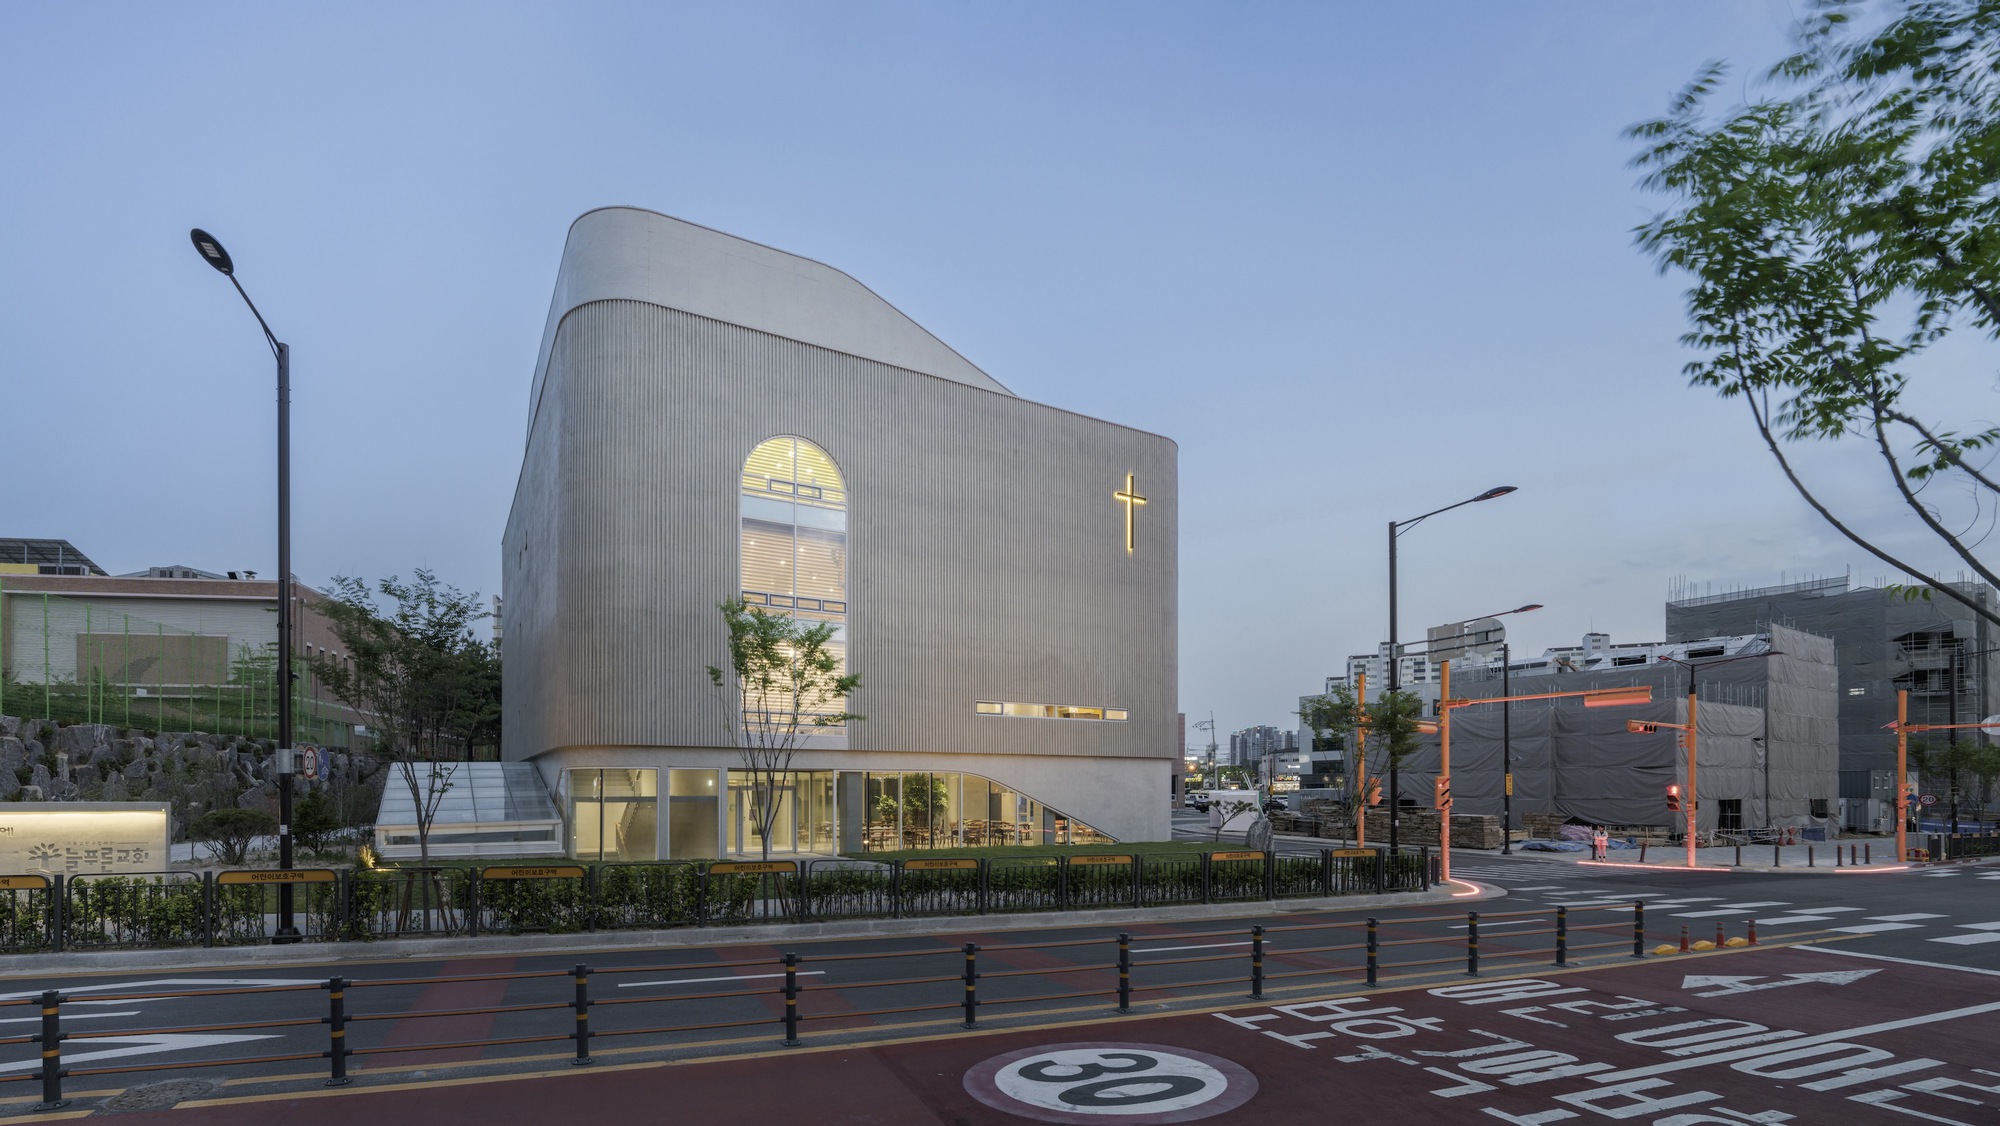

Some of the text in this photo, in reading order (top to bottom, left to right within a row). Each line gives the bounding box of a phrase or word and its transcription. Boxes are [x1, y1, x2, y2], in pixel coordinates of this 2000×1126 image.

[66, 847, 148, 873] 늘푸른교회
[734, 863, 773, 871] 어린이보호구역
[251, 872, 304, 880] 어린이보호구역
[511, 868, 557, 876] 어린이보호구역
[1018, 1053, 1206, 1106] 30
